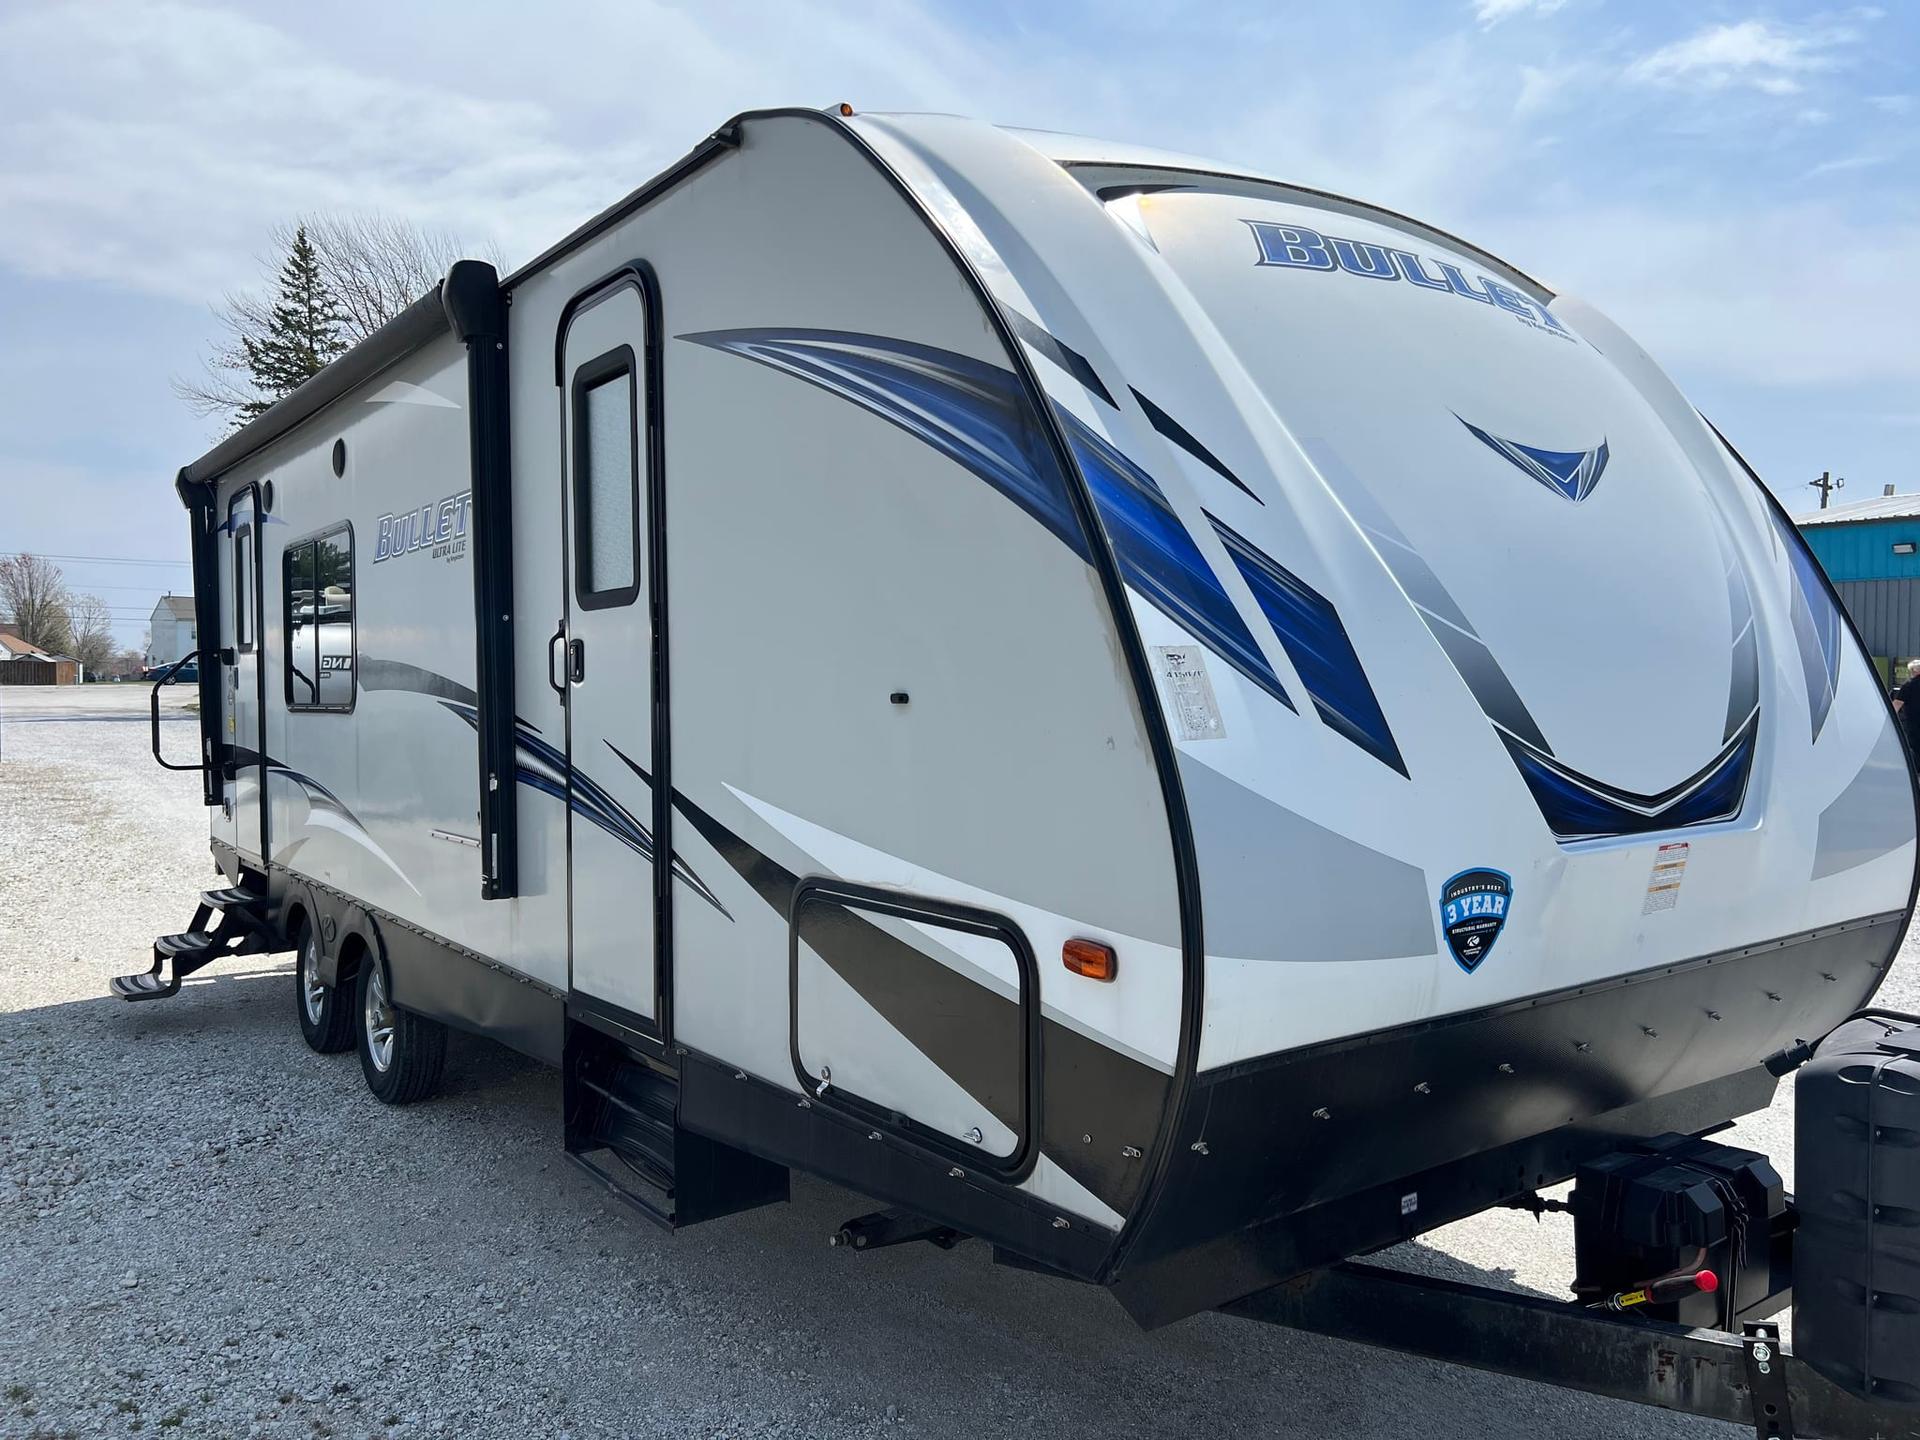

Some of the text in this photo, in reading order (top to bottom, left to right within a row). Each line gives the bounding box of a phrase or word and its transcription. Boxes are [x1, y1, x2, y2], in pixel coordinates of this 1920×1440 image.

[1238, 218, 1570, 335] BULLET
[373, 489, 472, 564] BULLET
[432, 544, 451, 559] ULTRA
[452, 540, 466, 554] LITE
[1447, 896, 1504, 924] 3 YEAR
